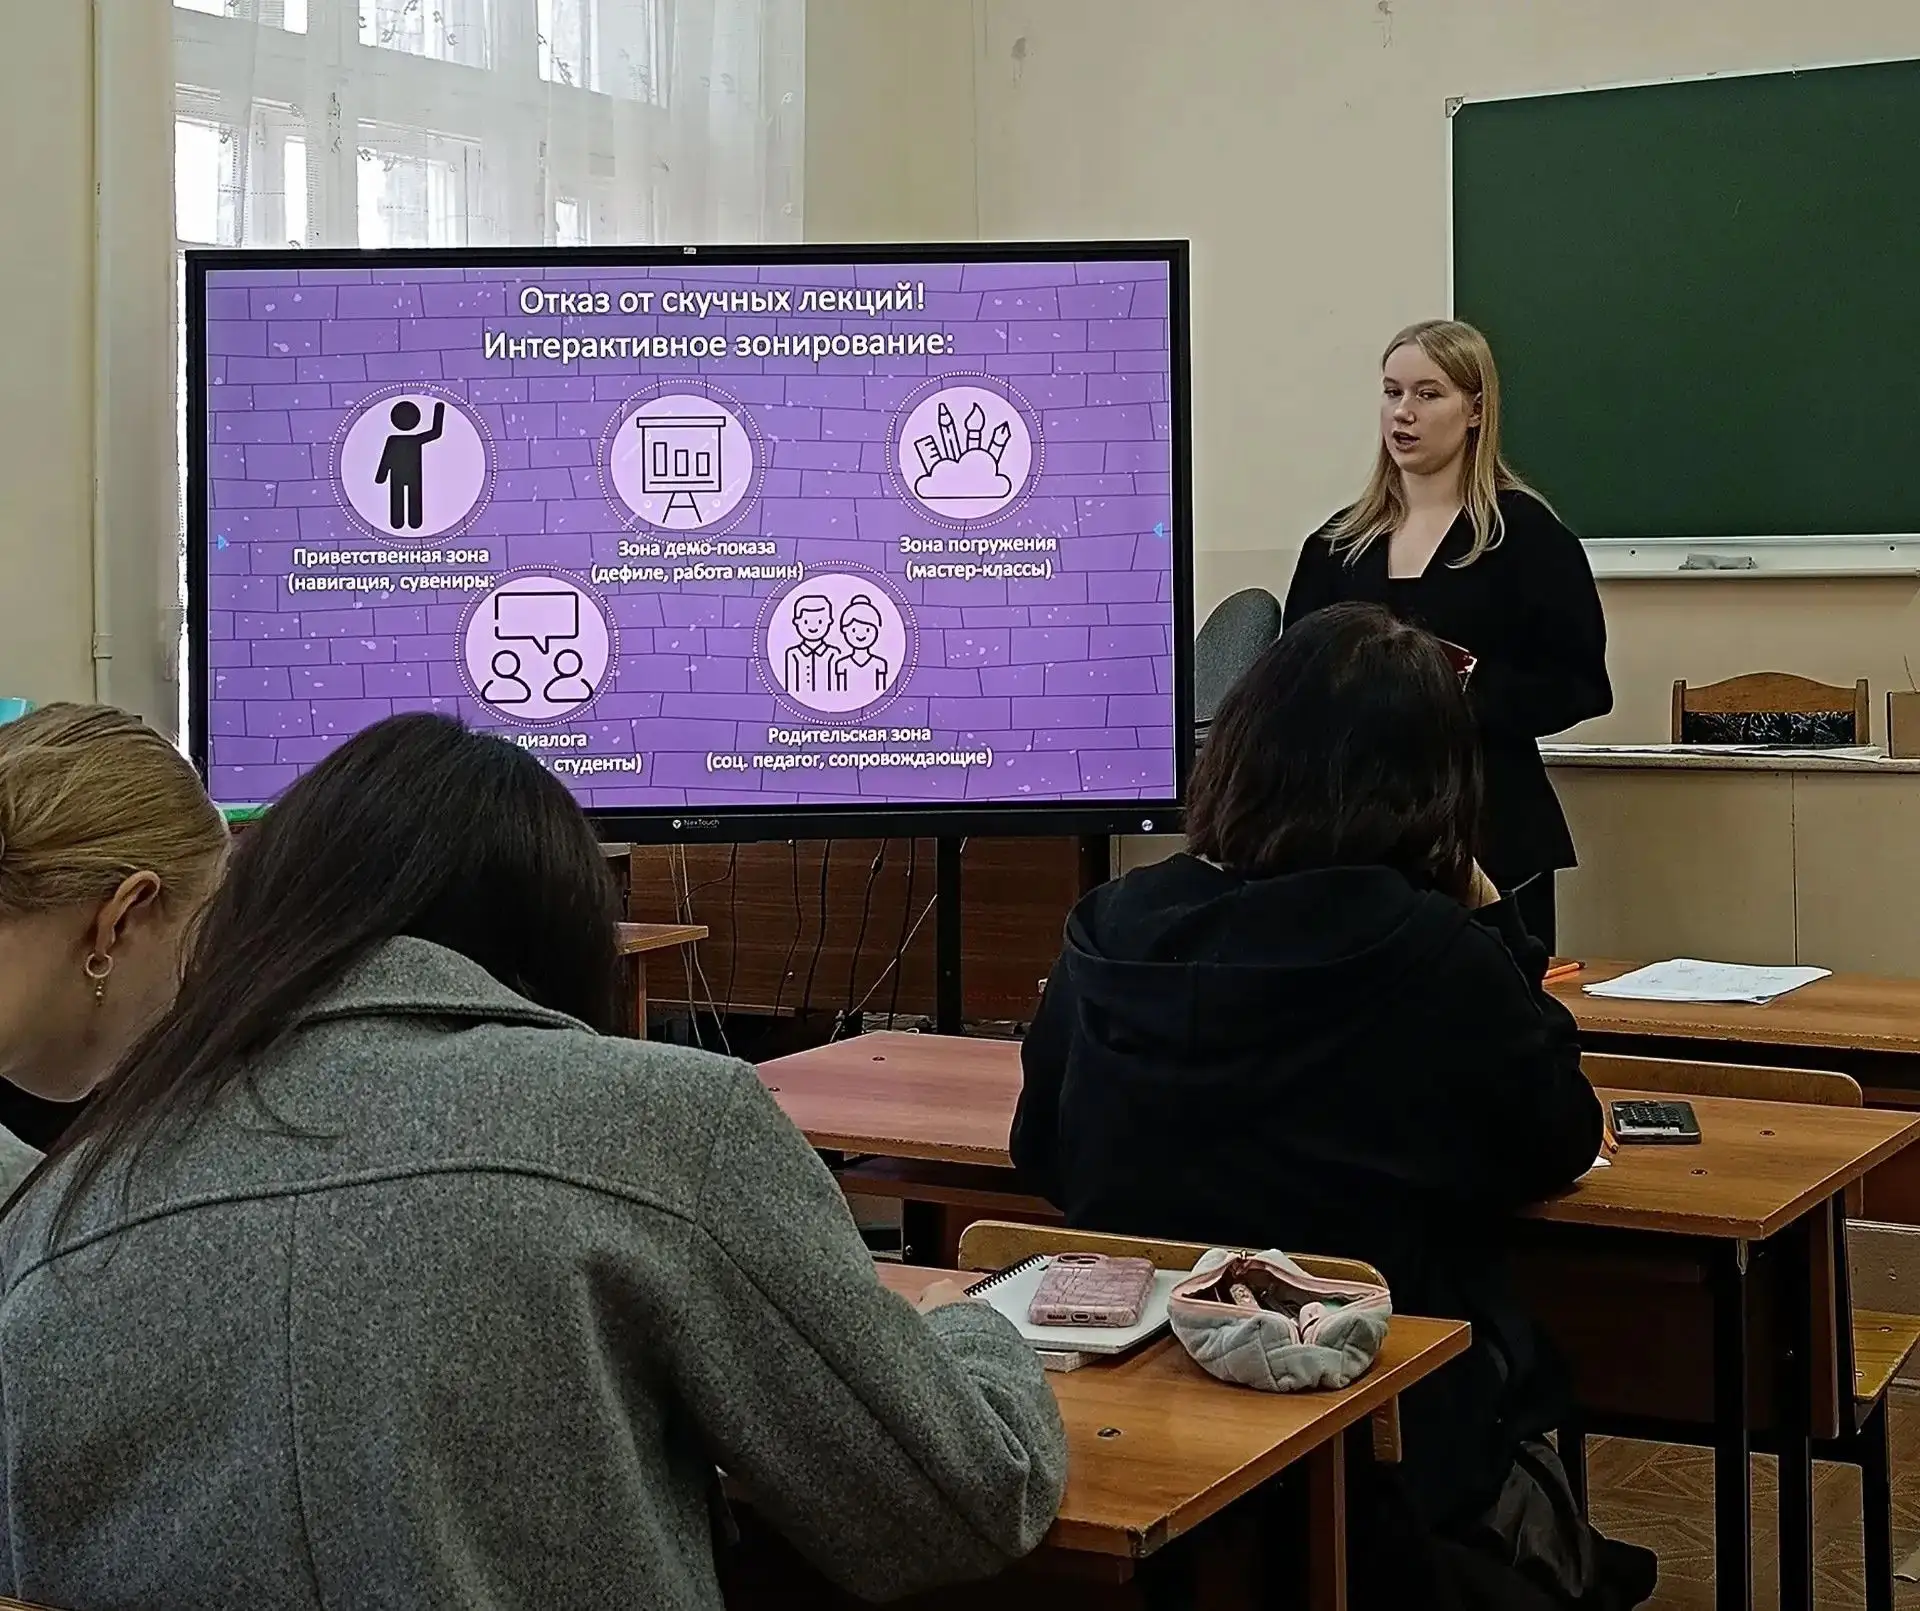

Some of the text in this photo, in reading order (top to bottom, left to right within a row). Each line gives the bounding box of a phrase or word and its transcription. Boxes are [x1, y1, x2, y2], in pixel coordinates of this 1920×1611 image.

[520, 282, 925, 318] Отказ от скучных лекций!
[484, 331, 954, 364] Интерактивное зонирование:
[618, 541, 776, 558] Зона демо-показа
[900, 536, 1057, 555] Зона погружения
[293, 549, 489, 568] Приветственная зона
[591, 561, 804, 583] (дефиле, работа машин)
[906, 558, 1052, 581] (мастер-классы)
[288, 573, 395, 593] (навигация,
[516, 734, 587, 750] диалога
[768, 727, 931, 746] Родительская зона
[554, 753, 643, 774] студенты)
[707, 748, 993, 772] (соц. педагог, сопровождающие)
